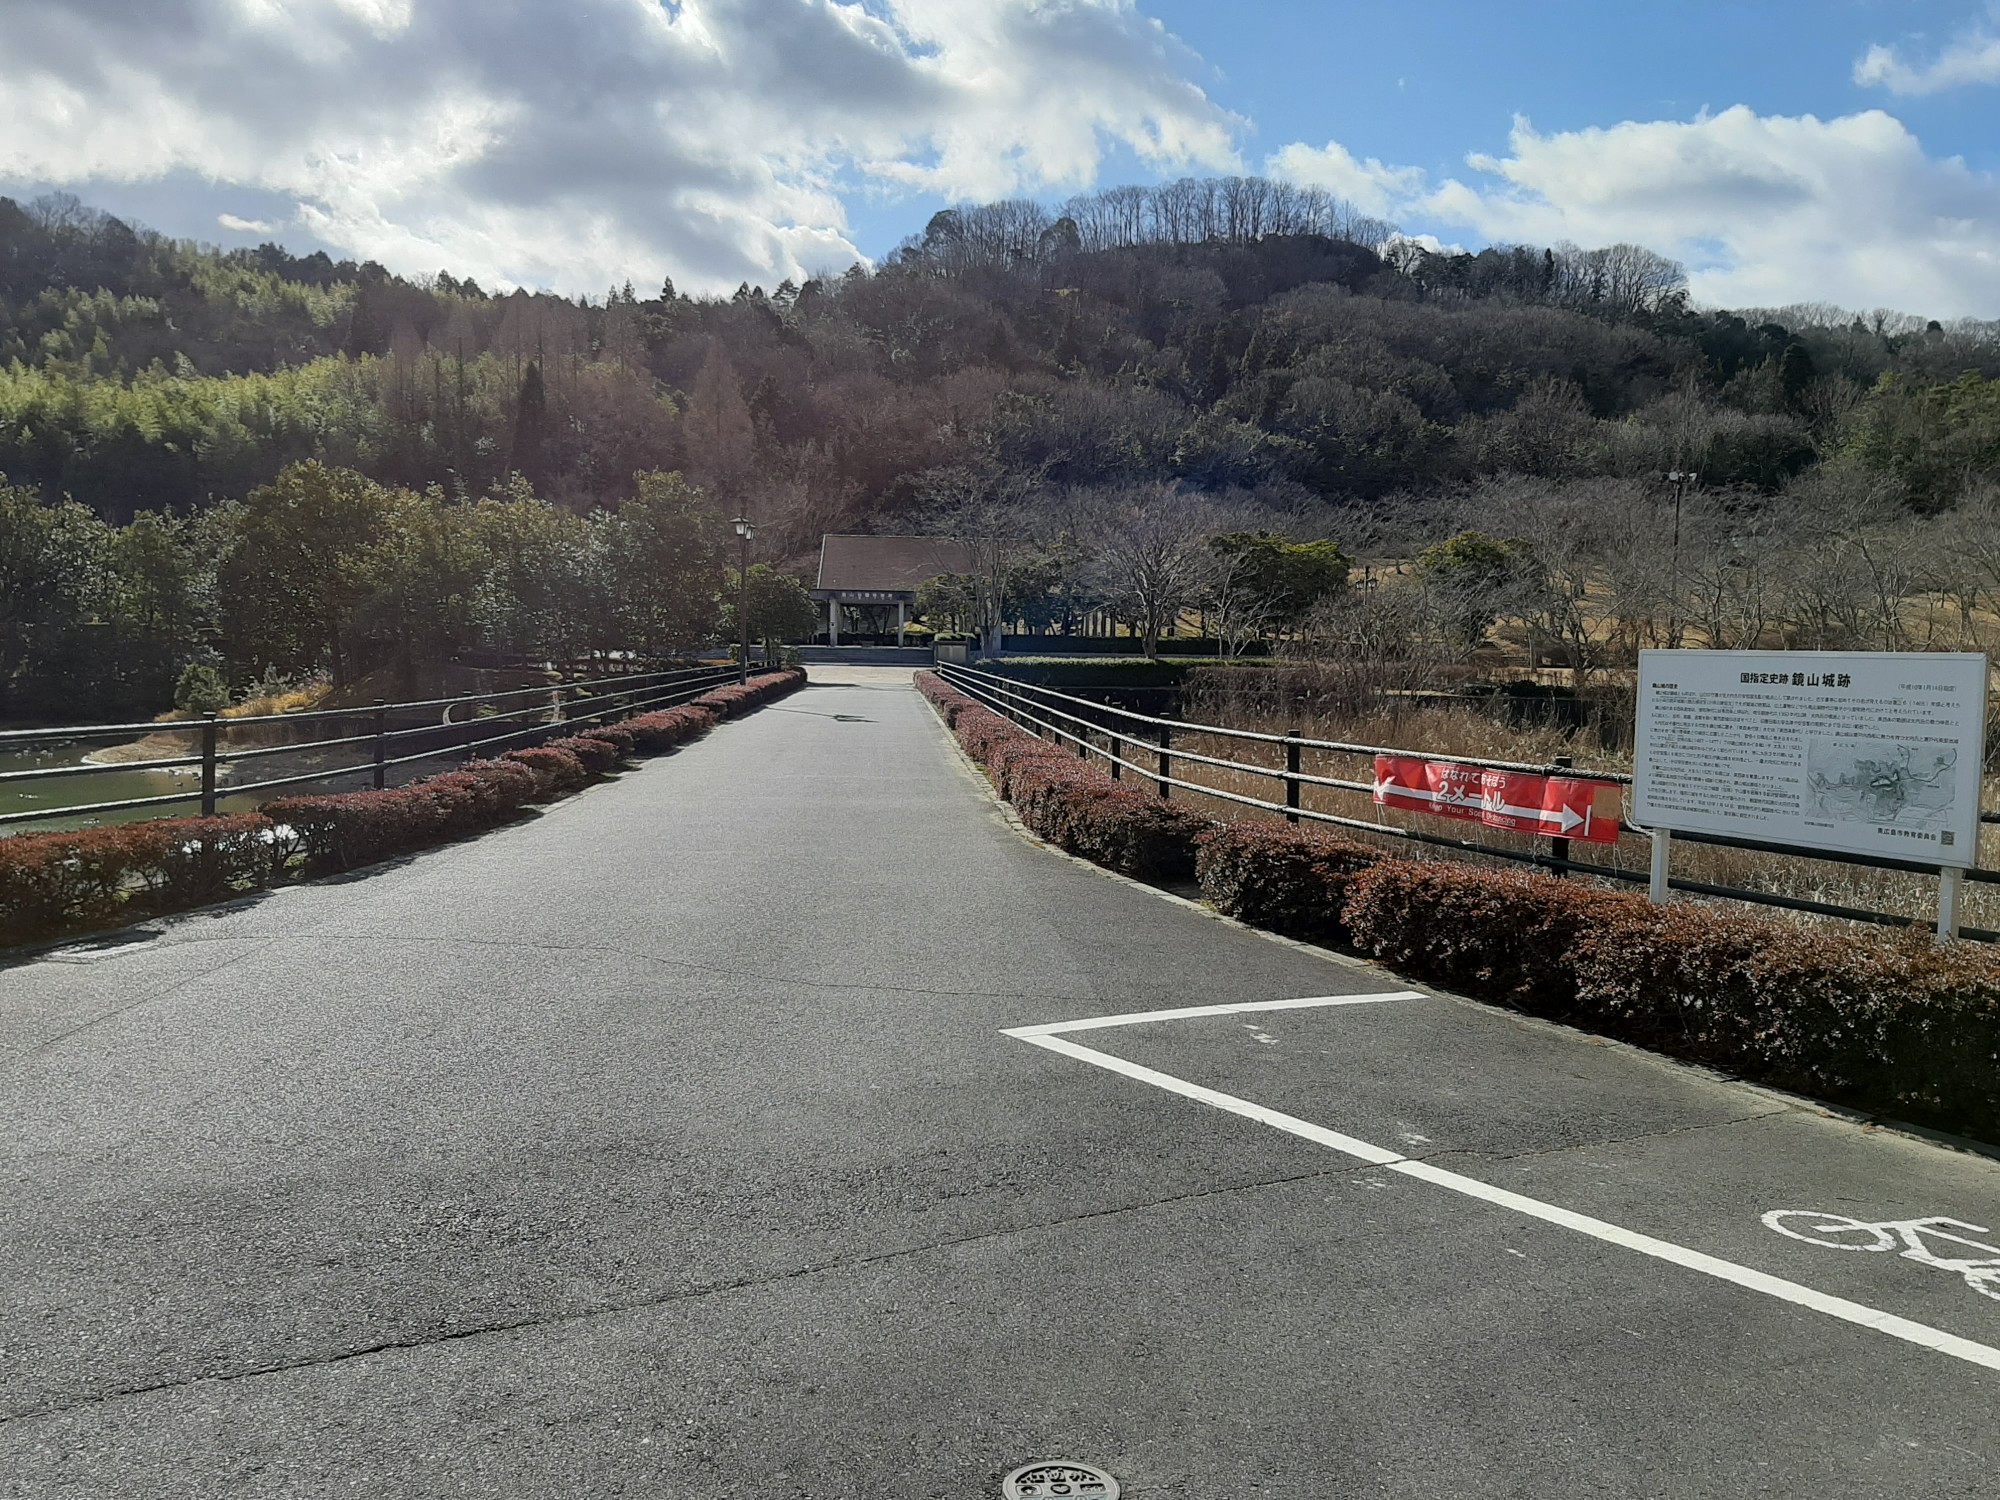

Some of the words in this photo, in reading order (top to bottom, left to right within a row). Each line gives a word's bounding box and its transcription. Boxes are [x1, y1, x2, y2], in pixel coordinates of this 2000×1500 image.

[1740, 672, 1789, 684] 国指定史跡
[1791, 672, 1851, 688] 鏡山城跡
[1436, 781, 1505, 811] 2メートル
[1447, 804, 1465, 814] Your
